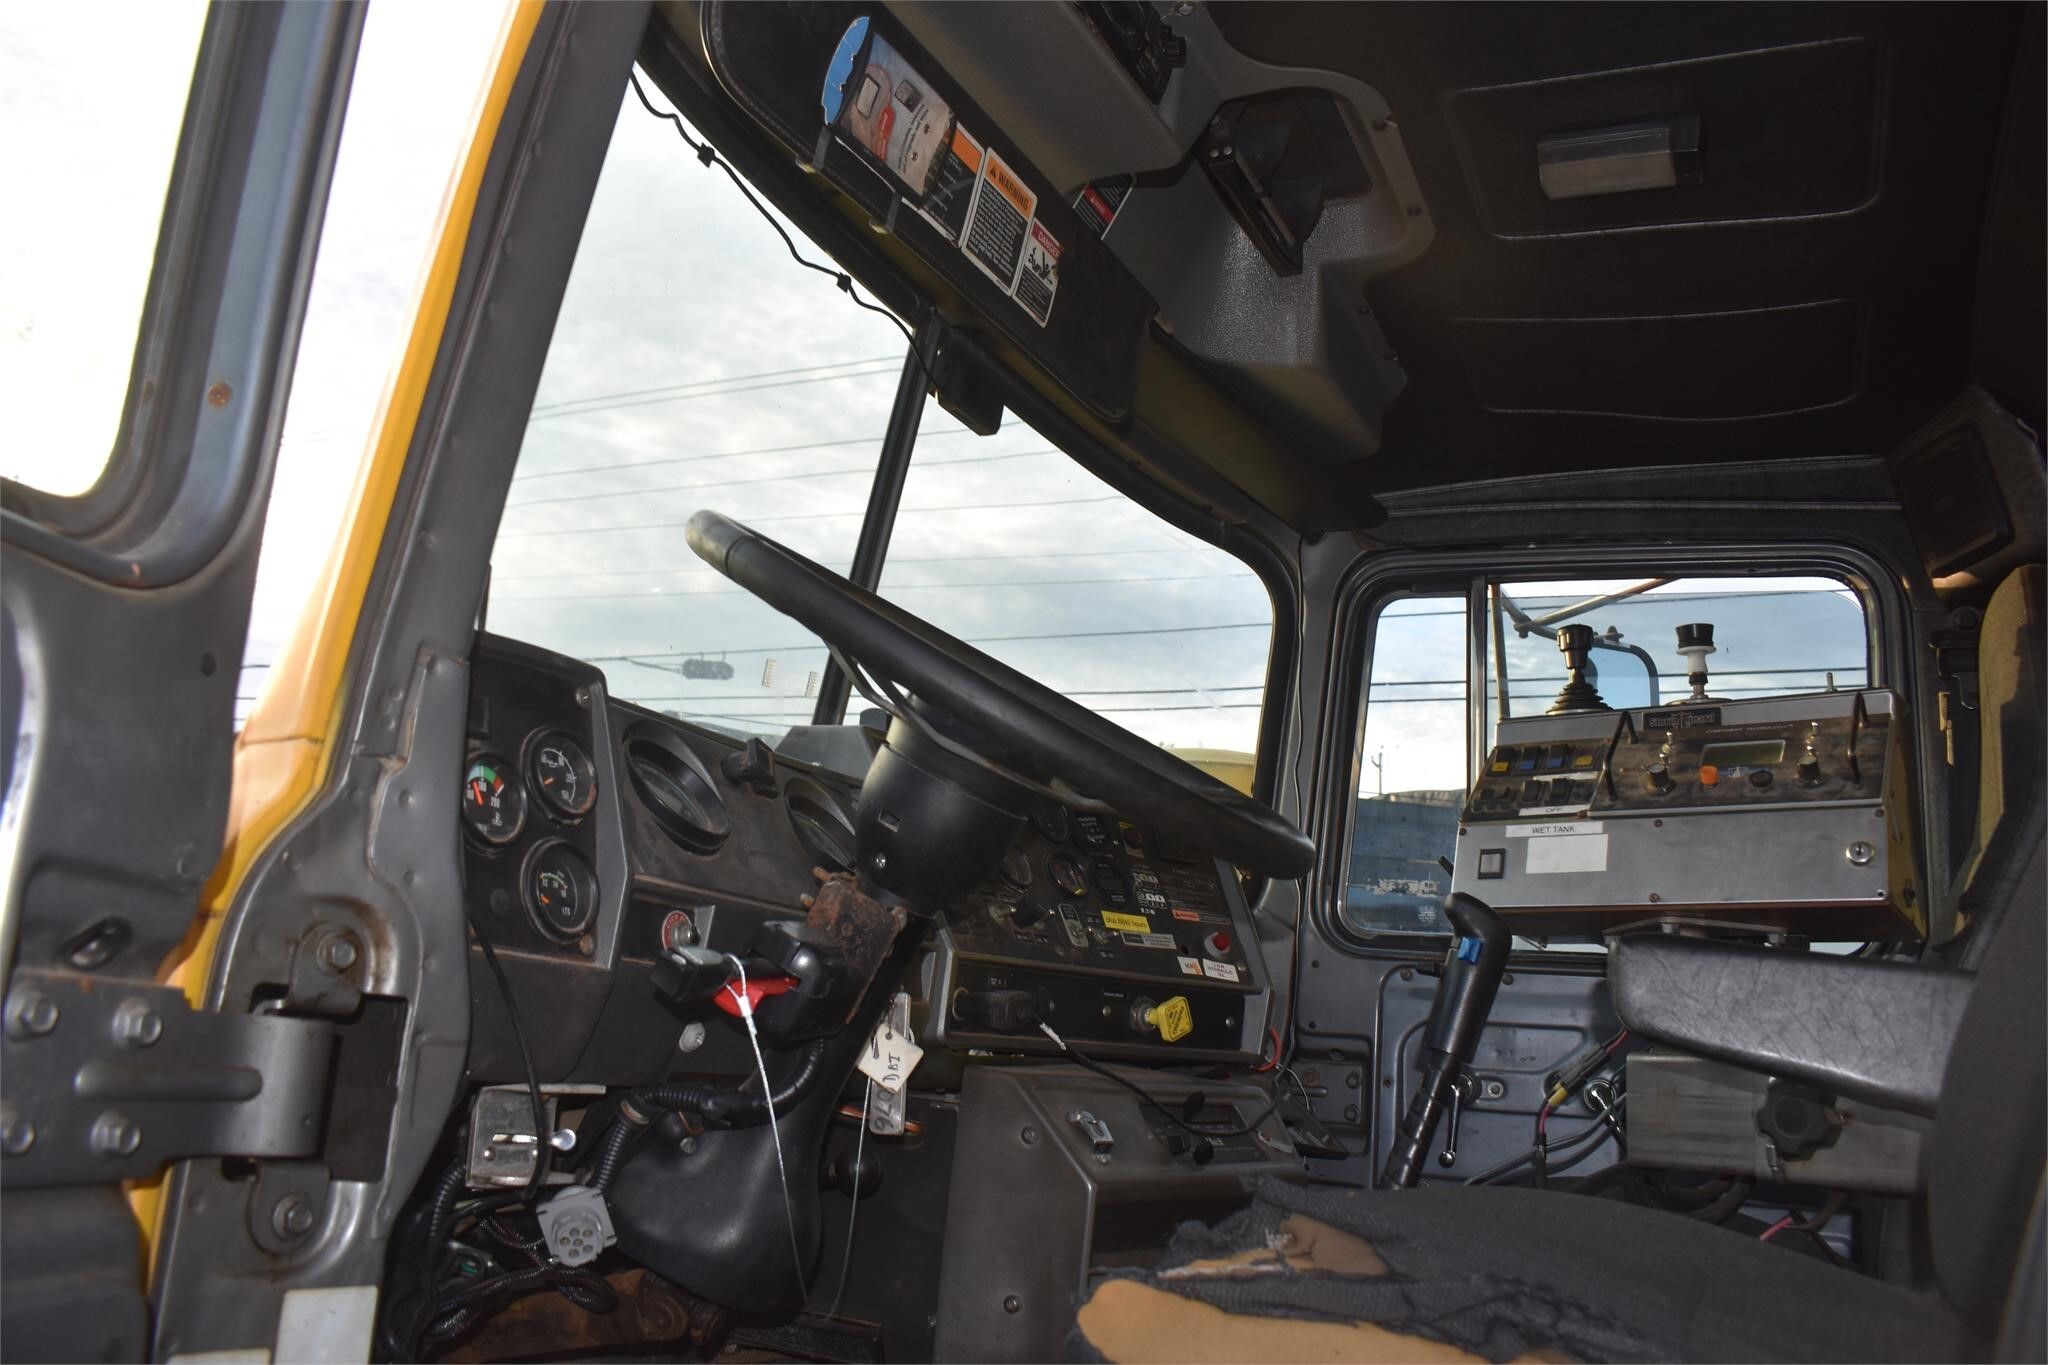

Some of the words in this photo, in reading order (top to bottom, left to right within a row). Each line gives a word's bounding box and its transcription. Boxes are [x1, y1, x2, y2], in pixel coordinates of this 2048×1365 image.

[996, 173, 1031, 212] WARNING
[1531, 826, 1551, 835] WET
[1553, 825, 1576, 834] TANK
